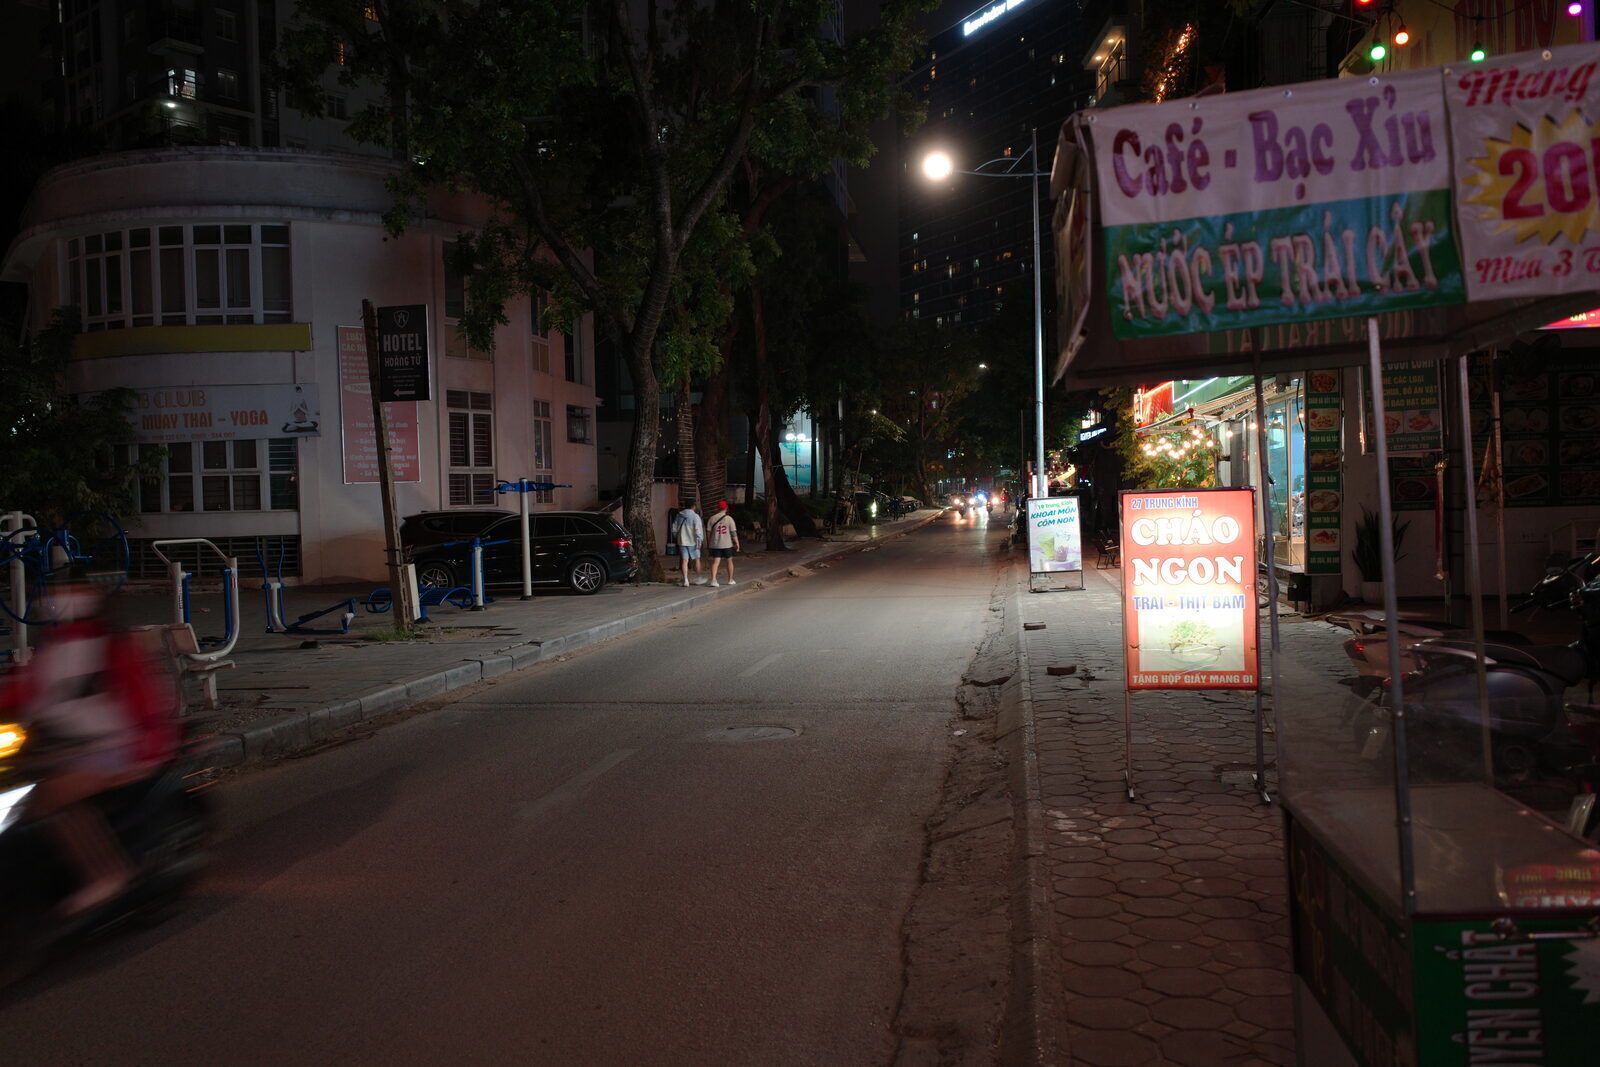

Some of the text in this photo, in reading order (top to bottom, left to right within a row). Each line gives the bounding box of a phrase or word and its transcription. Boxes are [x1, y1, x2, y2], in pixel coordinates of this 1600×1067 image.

[1112, 117, 1211, 198] Café
[1248, 110, 1335, 200] Bạc
[1345, 84, 1436, 172] Xỉu
[1218, 221, 1264, 311] ÉP
[1269, 209, 1362, 307] TRÁI
[1366, 200, 1439, 294] CÂY
[383, 332, 423, 352] HOTEL
[154, 389, 206, 409] CLUB
[143, 414, 178, 430] MUAY
[183, 412, 213, 429] THAI
[230, 410, 269, 426] YOGA
[1132, 495, 1198, 509] 27 TRUNG KÍNH
[1031, 509, 1056, 519] KHOAI
[716, 525, 727, 535] 42
[1131, 509, 1240, 546] CHÁO
[1131, 556, 1244, 586] NGON
[1133, 596, 1164, 610] TRAI
[1180, 595, 1208, 612] THỊT
[1132, 673, 1253, 685] TẶNG HỘP GIẤY MANG ĐI
